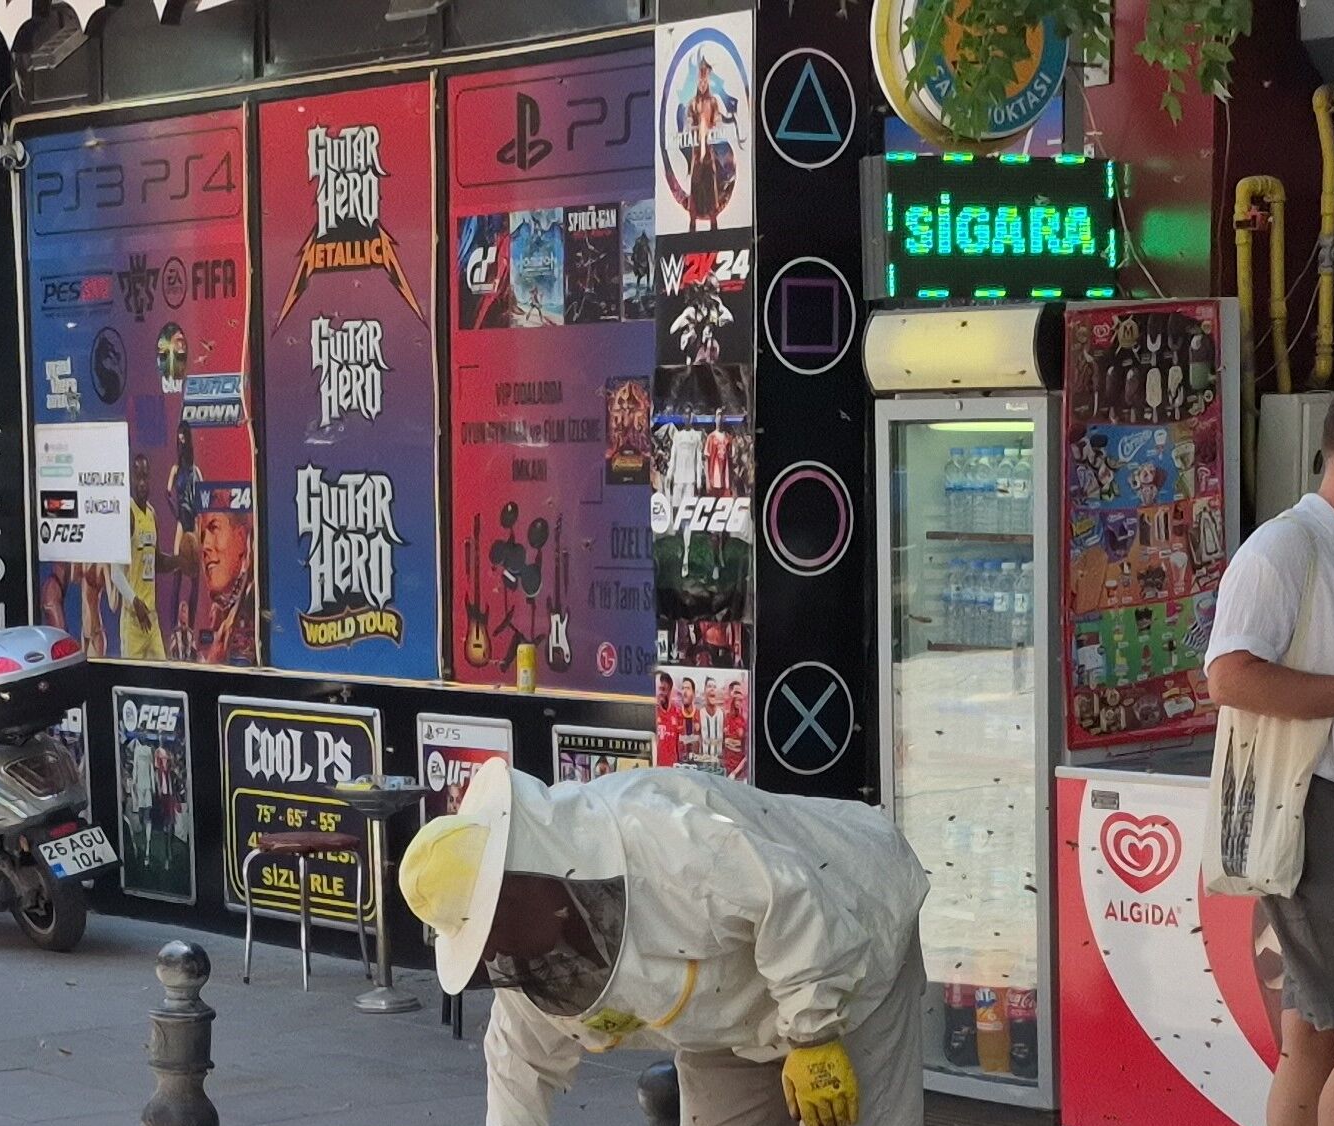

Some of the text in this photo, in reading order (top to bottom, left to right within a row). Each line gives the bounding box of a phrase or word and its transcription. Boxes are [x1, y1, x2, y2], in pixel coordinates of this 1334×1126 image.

[988, 72, 1052, 126] OKTASI
[36, 151, 236, 215] PS3 PS4
[905, 193, 1096, 255] SİGARA
[192, 258, 237, 301] FIFA
[300, 238, 402, 279] METALLICA
[303, 611, 398, 645] WORLD TOUR
[245, 720, 352, 784] COOL PS
[42, 827, 105, 860] 26 AGU
[70, 851, 104, 870] 104
[261, 863, 345, 897] SİZLRLE
